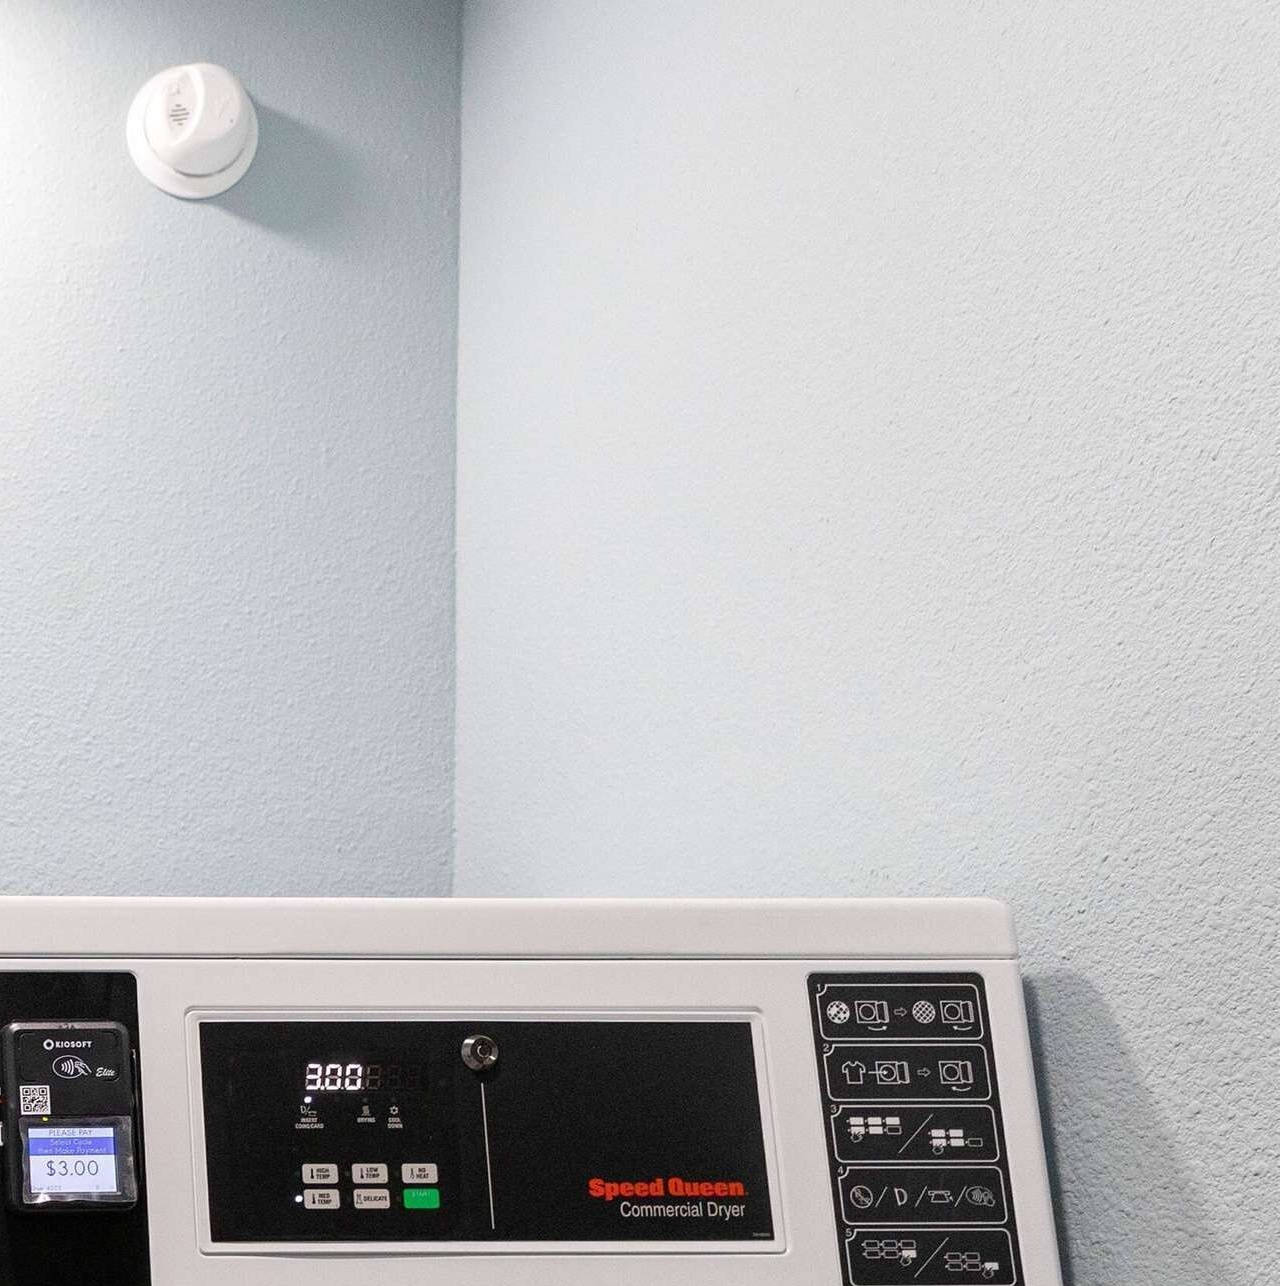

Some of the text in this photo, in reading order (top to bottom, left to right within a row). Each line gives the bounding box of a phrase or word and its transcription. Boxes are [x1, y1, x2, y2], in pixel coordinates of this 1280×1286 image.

[823, 1044, 829, 1052] 2
[96, 1067, 115, 1076] Elite
[46, 1160, 99, 1176] $3.00
[588, 1177, 744, 1200] Speed Queen
[620, 1201, 745, 1221] Commercial Dryer
[845, 1229, 852, 1237] 5
